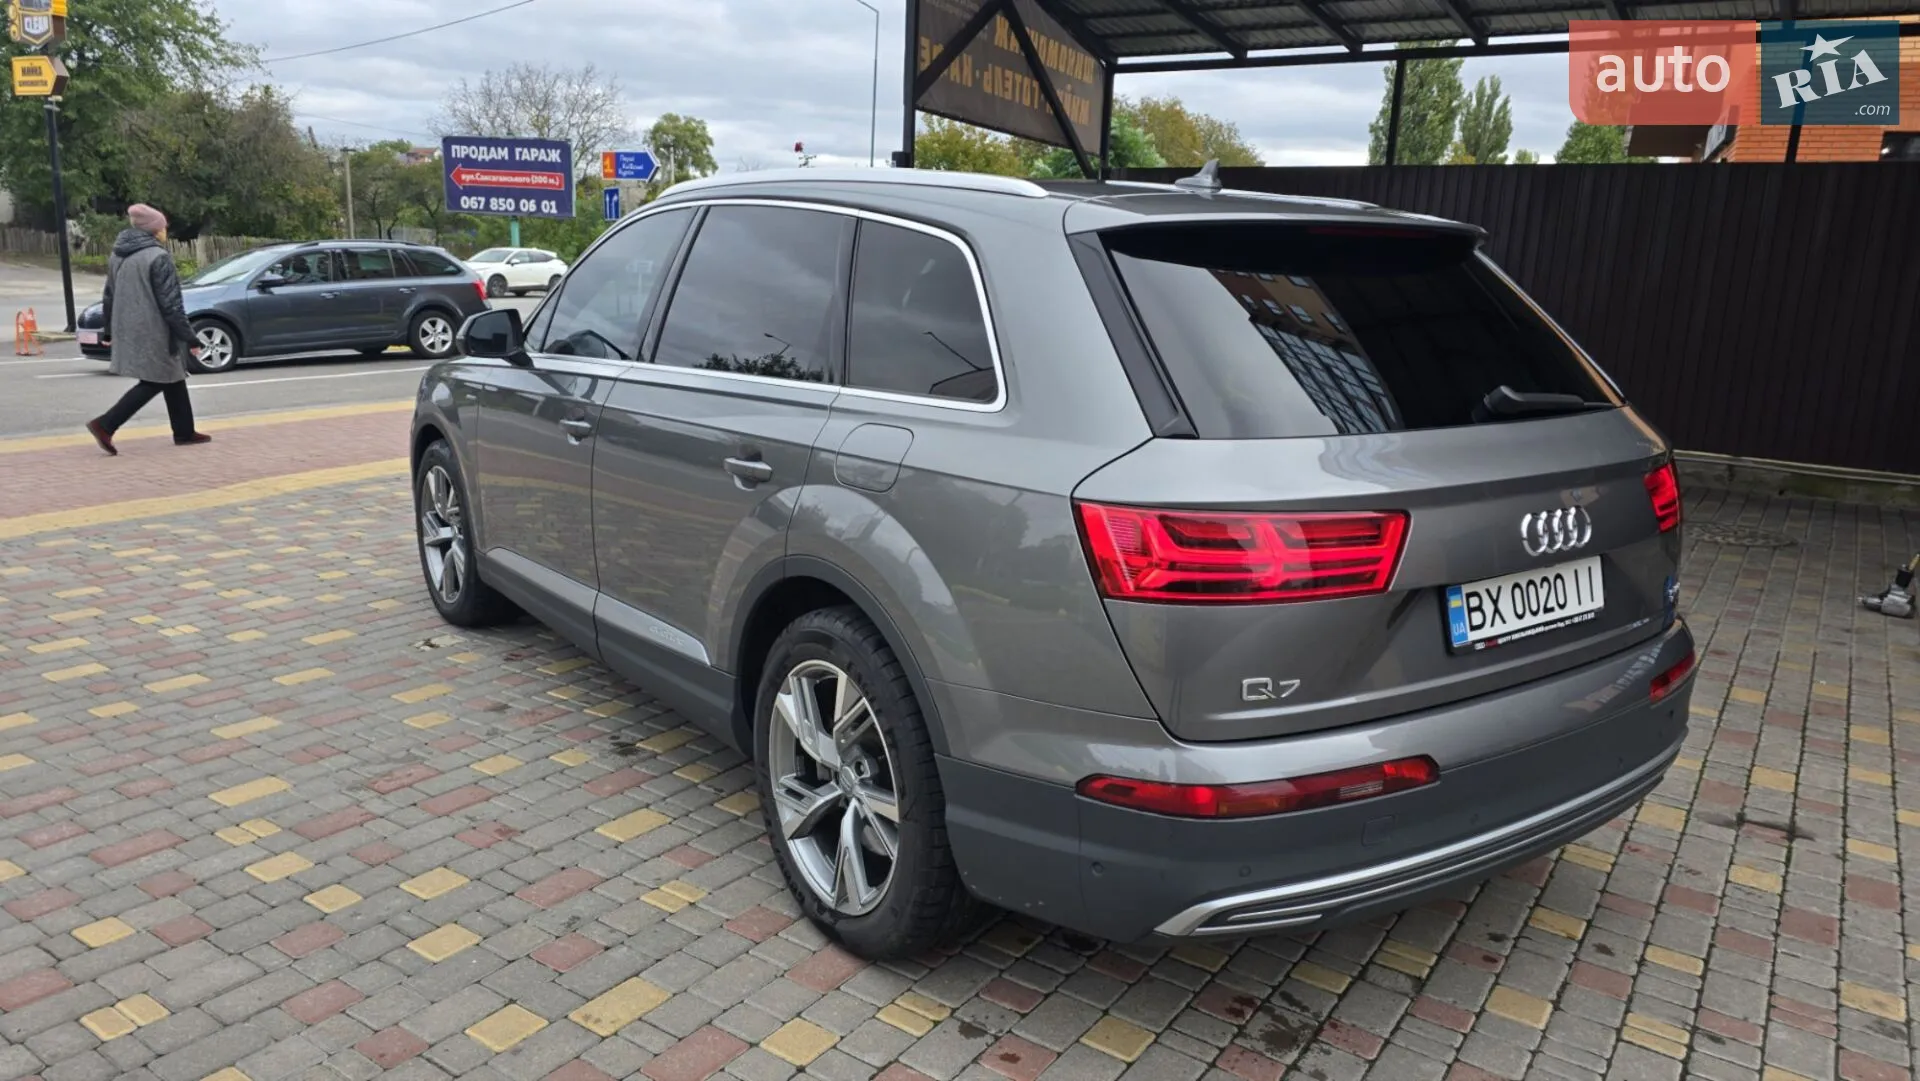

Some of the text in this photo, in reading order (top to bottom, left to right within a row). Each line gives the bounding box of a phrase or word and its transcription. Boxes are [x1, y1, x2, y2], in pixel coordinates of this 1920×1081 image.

[451, 144, 562, 163] ПРОДАМ ГАРАЖ
[460, 196, 558, 214] 067 850 06 01
[1465, 585, 1507, 632] BX
[1511, 572, 1568, 620] 0020
[1452, 621, 1466, 636] UA
[1242, 677, 1301, 701] Q7
